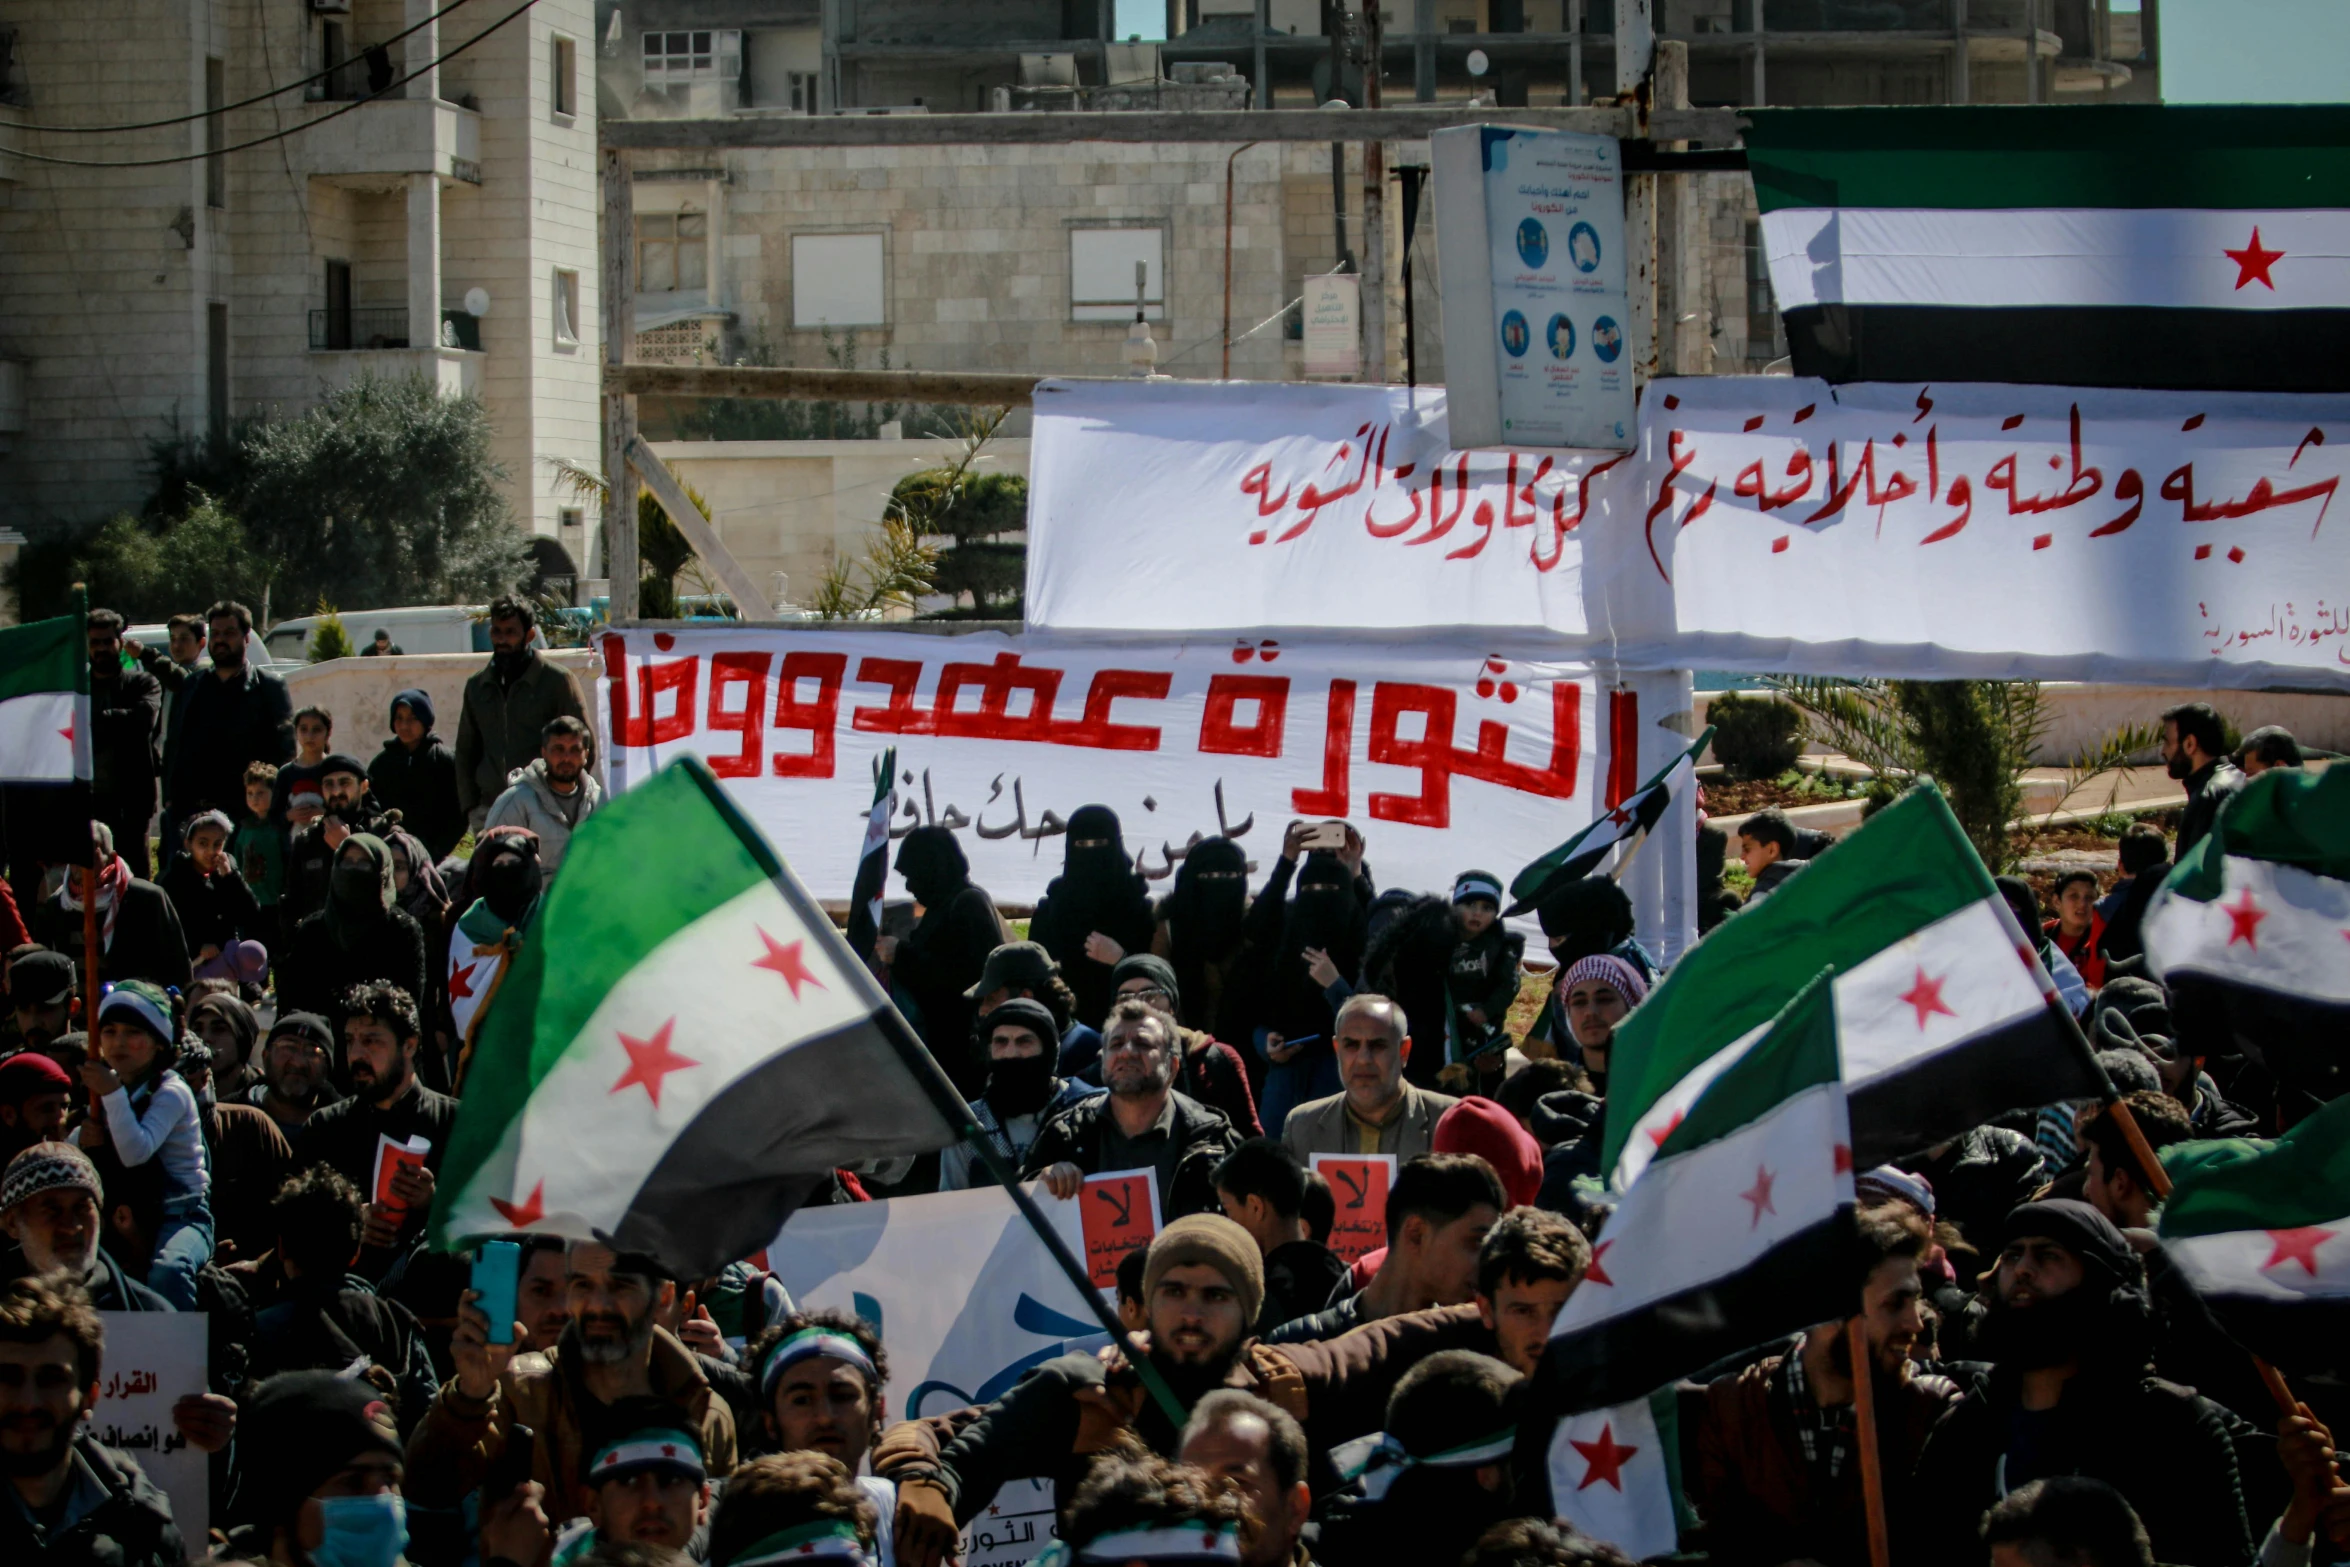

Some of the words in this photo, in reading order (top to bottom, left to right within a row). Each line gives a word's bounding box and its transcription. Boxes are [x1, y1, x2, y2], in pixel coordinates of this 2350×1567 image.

[1530, 200, 1565, 214] الكورونا
[1565, 204, 1579, 216] من
[1644, 393, 1719, 585] رغم
[1733, 383, 1972, 554] وأخلاقية
[1984, 400, 2145, 551] وطنية
[2160, 412, 2342, 564] شعبية
[1530, 448, 1638, 573] كل
[2198, 600, 2285, 656] السورية
[852, 650, 1175, 752] عهد
[1197, 638, 1639, 829] الثورة
[1096, 1181, 1131, 1228] لا
[1335, 1164, 1371, 1209] لا
[104, 1369, 157, 1400] القرار
[100, 1423, 158, 1452] إنصاف
[956, 1519, 1035, 1556] الثوري
